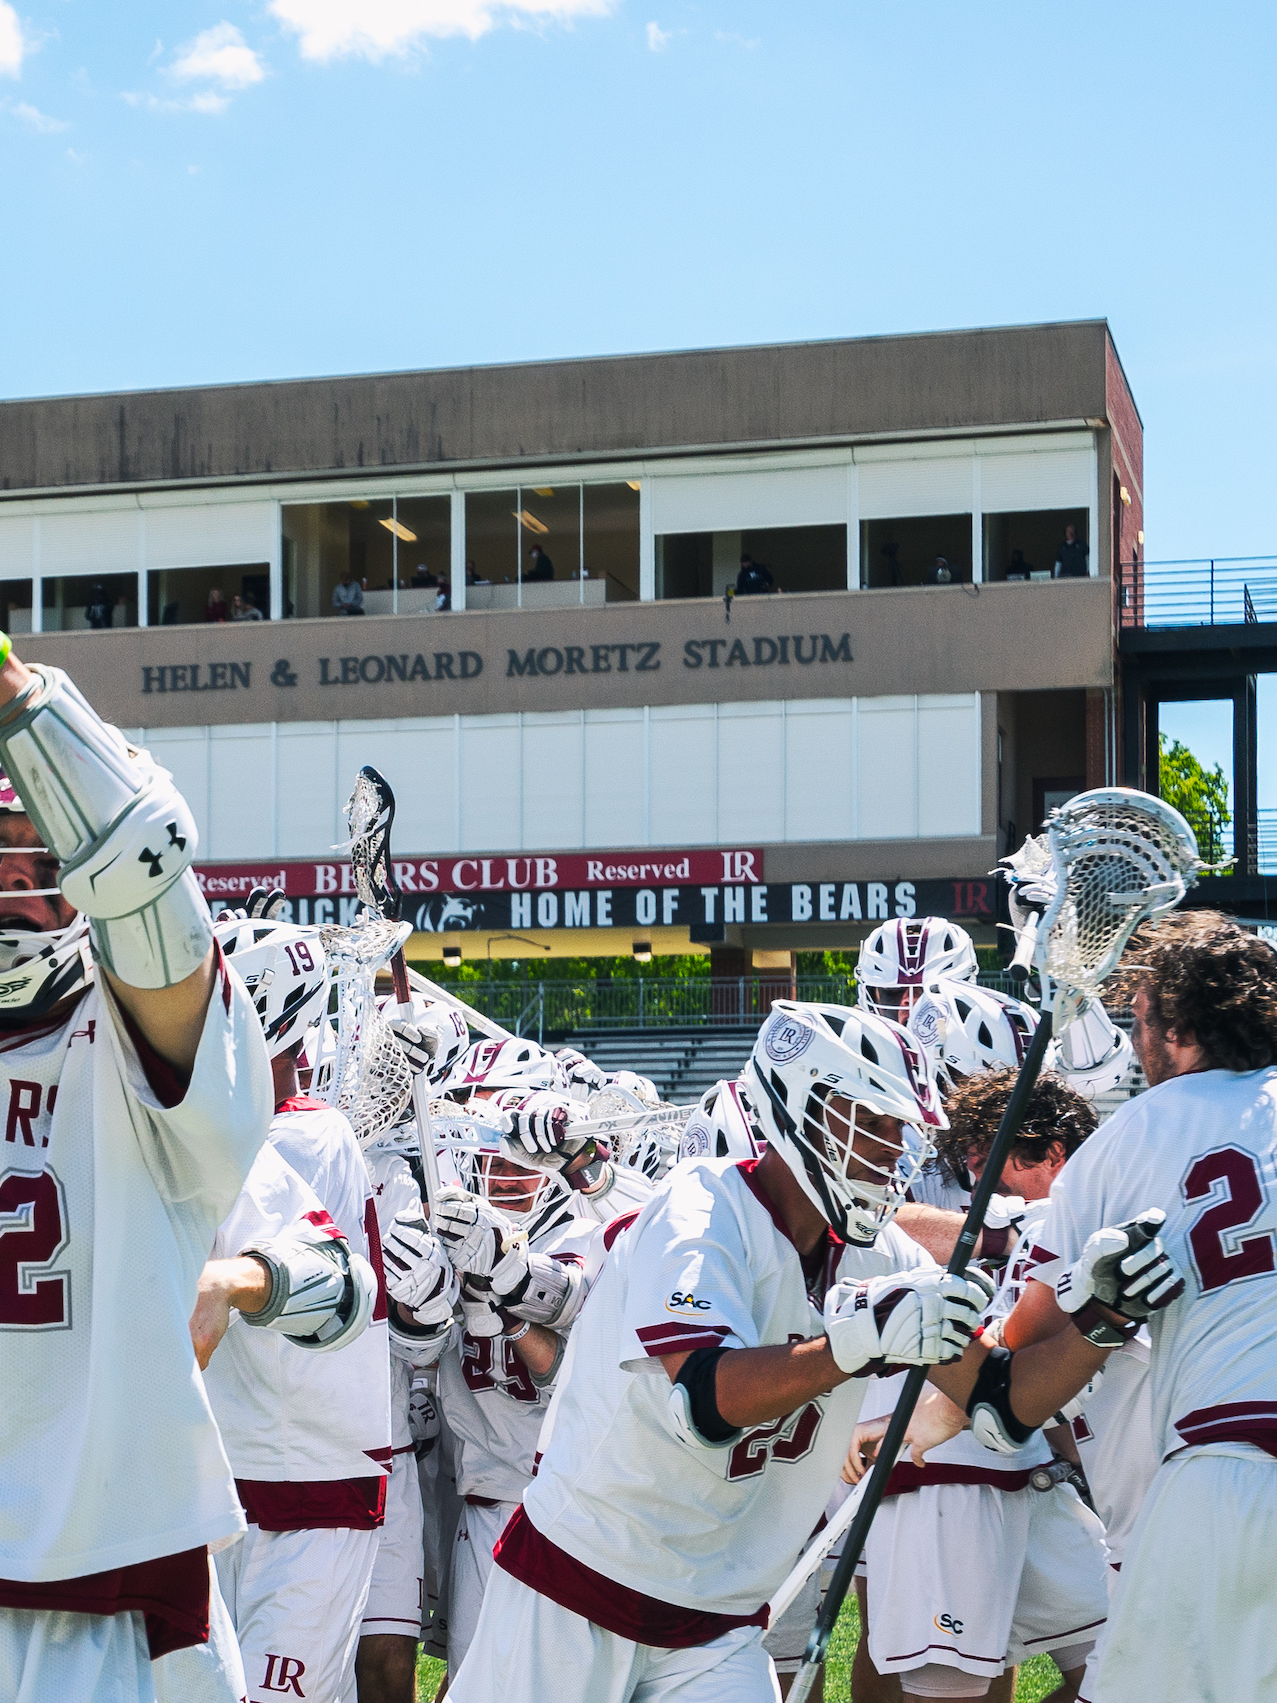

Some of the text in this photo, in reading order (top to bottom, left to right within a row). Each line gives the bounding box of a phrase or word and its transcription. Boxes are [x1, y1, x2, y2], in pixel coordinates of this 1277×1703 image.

[141, 632, 855, 694] HELEN & LEONARD MORETZ STADIUM
[314, 860, 440, 895] BERS
[451, 856, 559, 896] CLUB
[586, 857, 690, 882] Reserved
[720, 850, 759, 883] LR
[510, 889, 614, 929] HOME
[635, 888, 680, 926] OF
[700, 885, 769, 924] THE
[791, 881, 917, 922] BEARS
[284, 941, 315, 977] 19
[449, 1011, 466, 1038] 18
[1178, 1141, 1277, 1301] 2
[669, 1291, 712, 1310] SAC
[258, 1653, 306, 1698] LR
